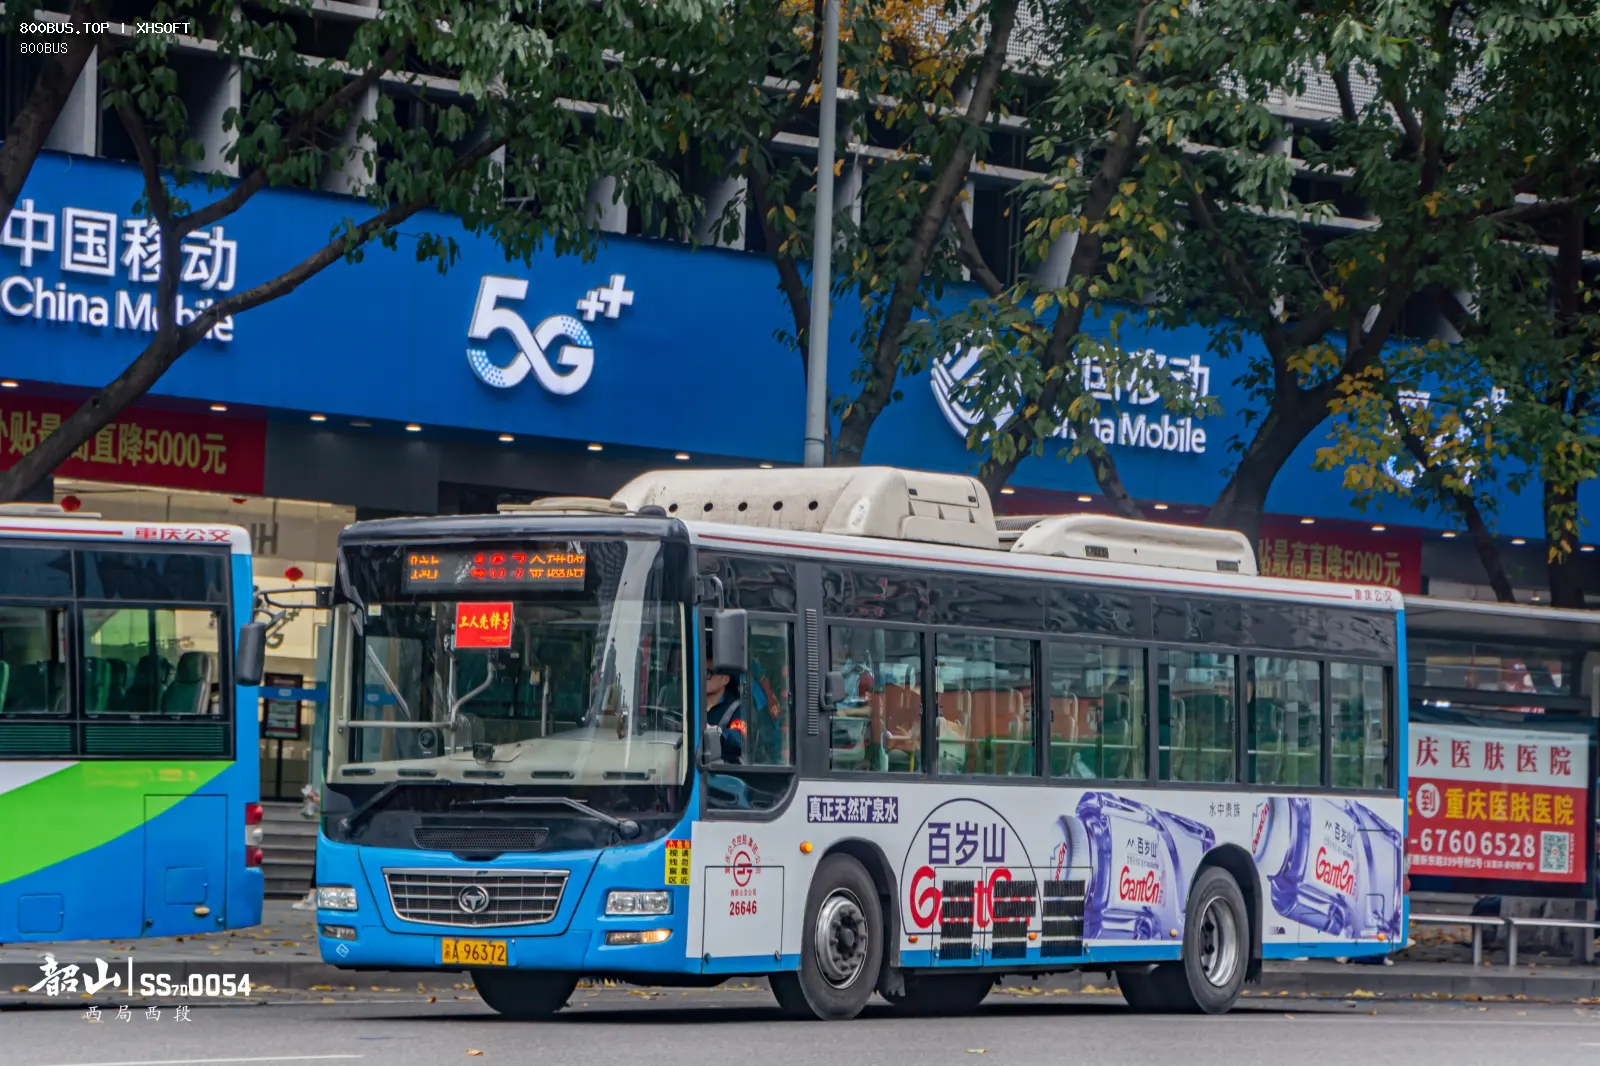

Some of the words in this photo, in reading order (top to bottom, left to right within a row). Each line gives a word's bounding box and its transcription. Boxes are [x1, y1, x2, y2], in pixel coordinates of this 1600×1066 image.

[0, 198, 239, 291] 中国移动
[1, 276, 109, 327] China
[1117, 412, 1206, 454] Mobile
[135, 527, 231, 543] 重庆公交
[458, 610, 510, 631] 工人先锋号
[1416, 735, 1572, 776] 庆医肤医院
[808, 796, 897, 823] 真正天然矿泉水
[1208, 801, 1241, 818] 水中贵族
[1445, 787, 1575, 826] 重庆医肤医院
[928, 821, 1006, 866] 百岁山
[1137, 836, 1158, 859] 百岁山
[1335, 822, 1353, 849] 百岁山
[669, 849, 678, 884] 视线盲区
[680, 849, 689, 885] 请勿靠近
[1119, 865, 1160, 904] Ganten
[1315, 846, 1355, 895] Ganten
[729, 900, 757, 916] 26646
